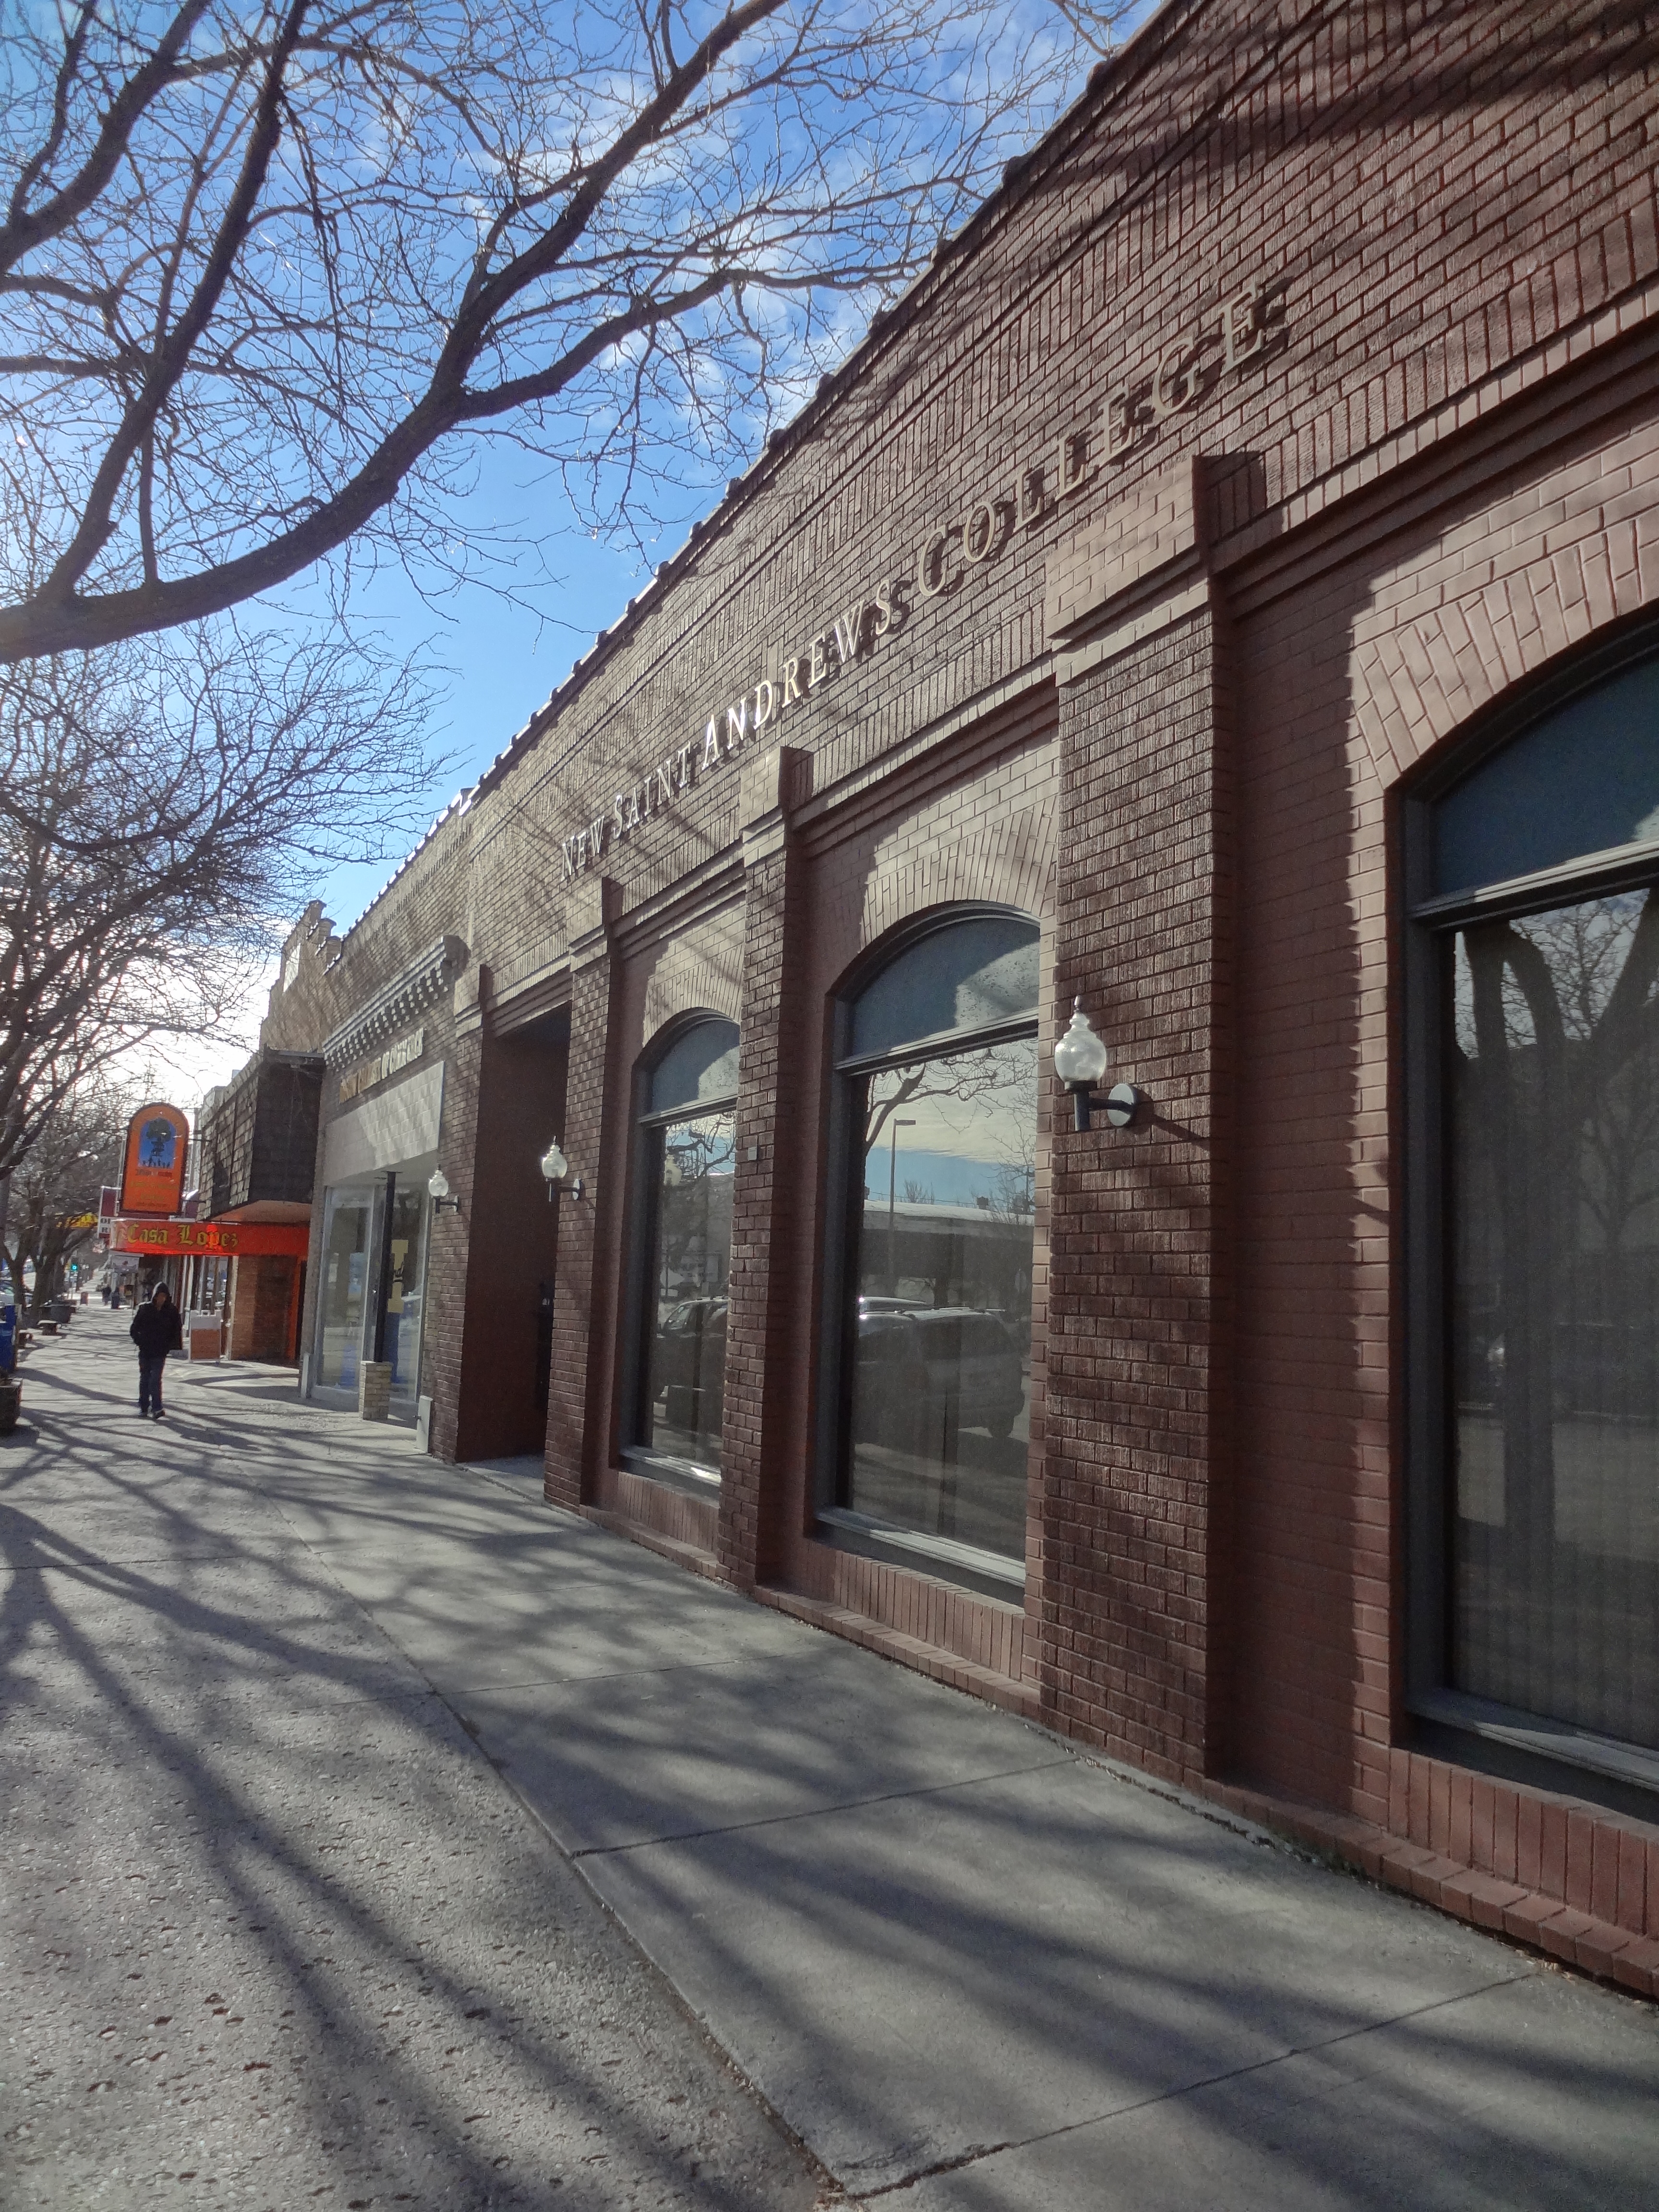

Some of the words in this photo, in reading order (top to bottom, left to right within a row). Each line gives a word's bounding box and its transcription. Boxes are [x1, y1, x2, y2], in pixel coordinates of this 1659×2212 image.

[561, 816, 605, 881] NEW
[613, 742, 691, 840] SAINT
[701, 579, 892, 771] ANDREWS
[918, 282, 1263, 597] COLLEGE
[127, 1223, 168, 1245] Casa
[177, 1224, 239, 1248] Lopez
